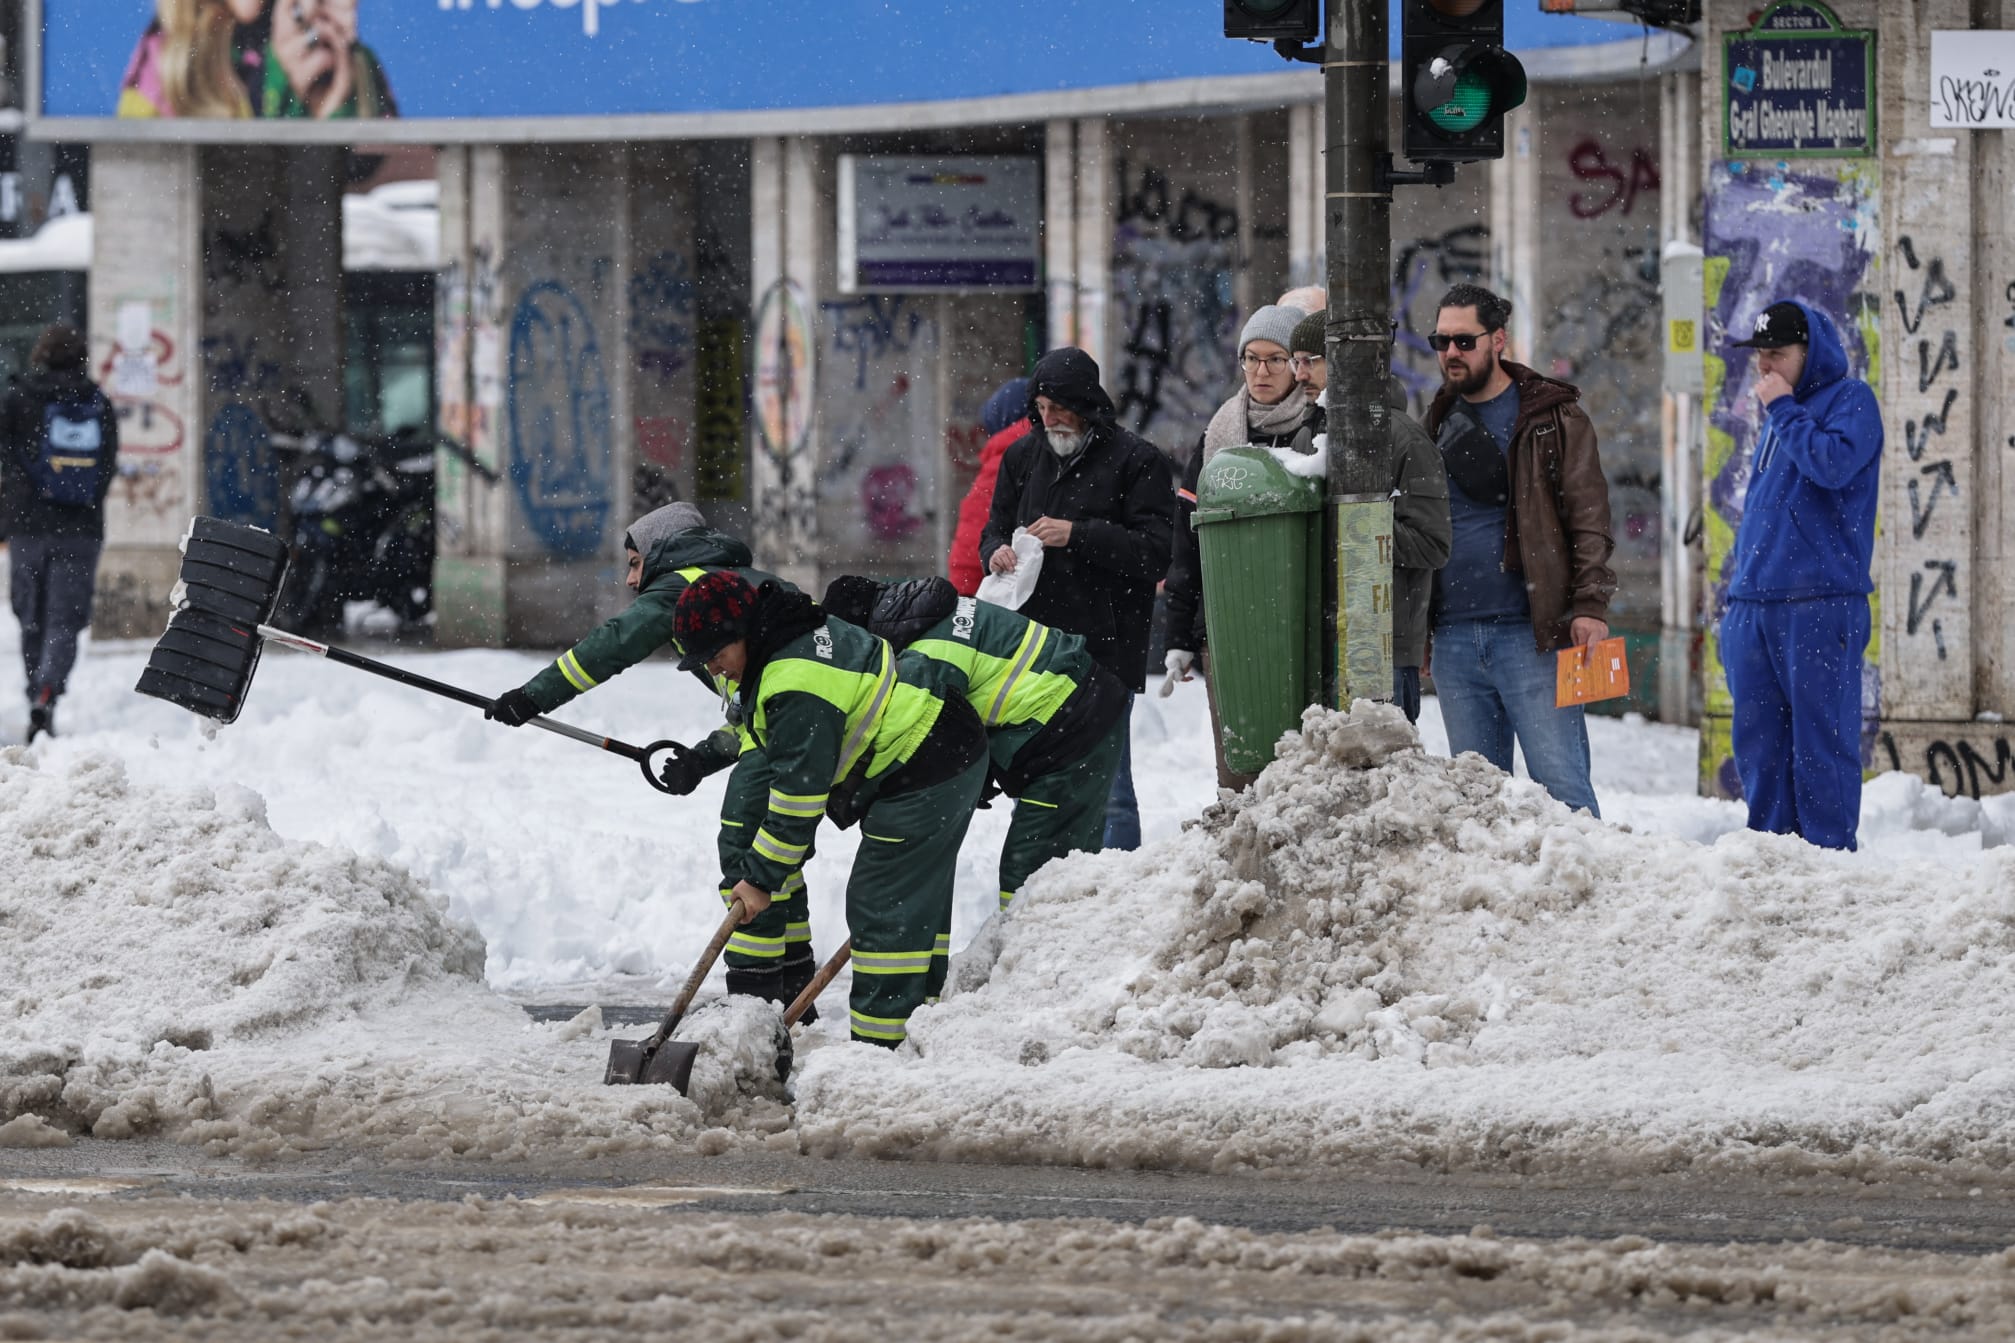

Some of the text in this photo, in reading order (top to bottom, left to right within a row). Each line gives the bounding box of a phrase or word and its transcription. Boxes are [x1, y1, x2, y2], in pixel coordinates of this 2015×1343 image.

[1772, 16, 1813, 28] SECTOR
[1762, 49, 1832, 90] Bulevardul
[1761, 100, 1815, 149] Gheorghe
